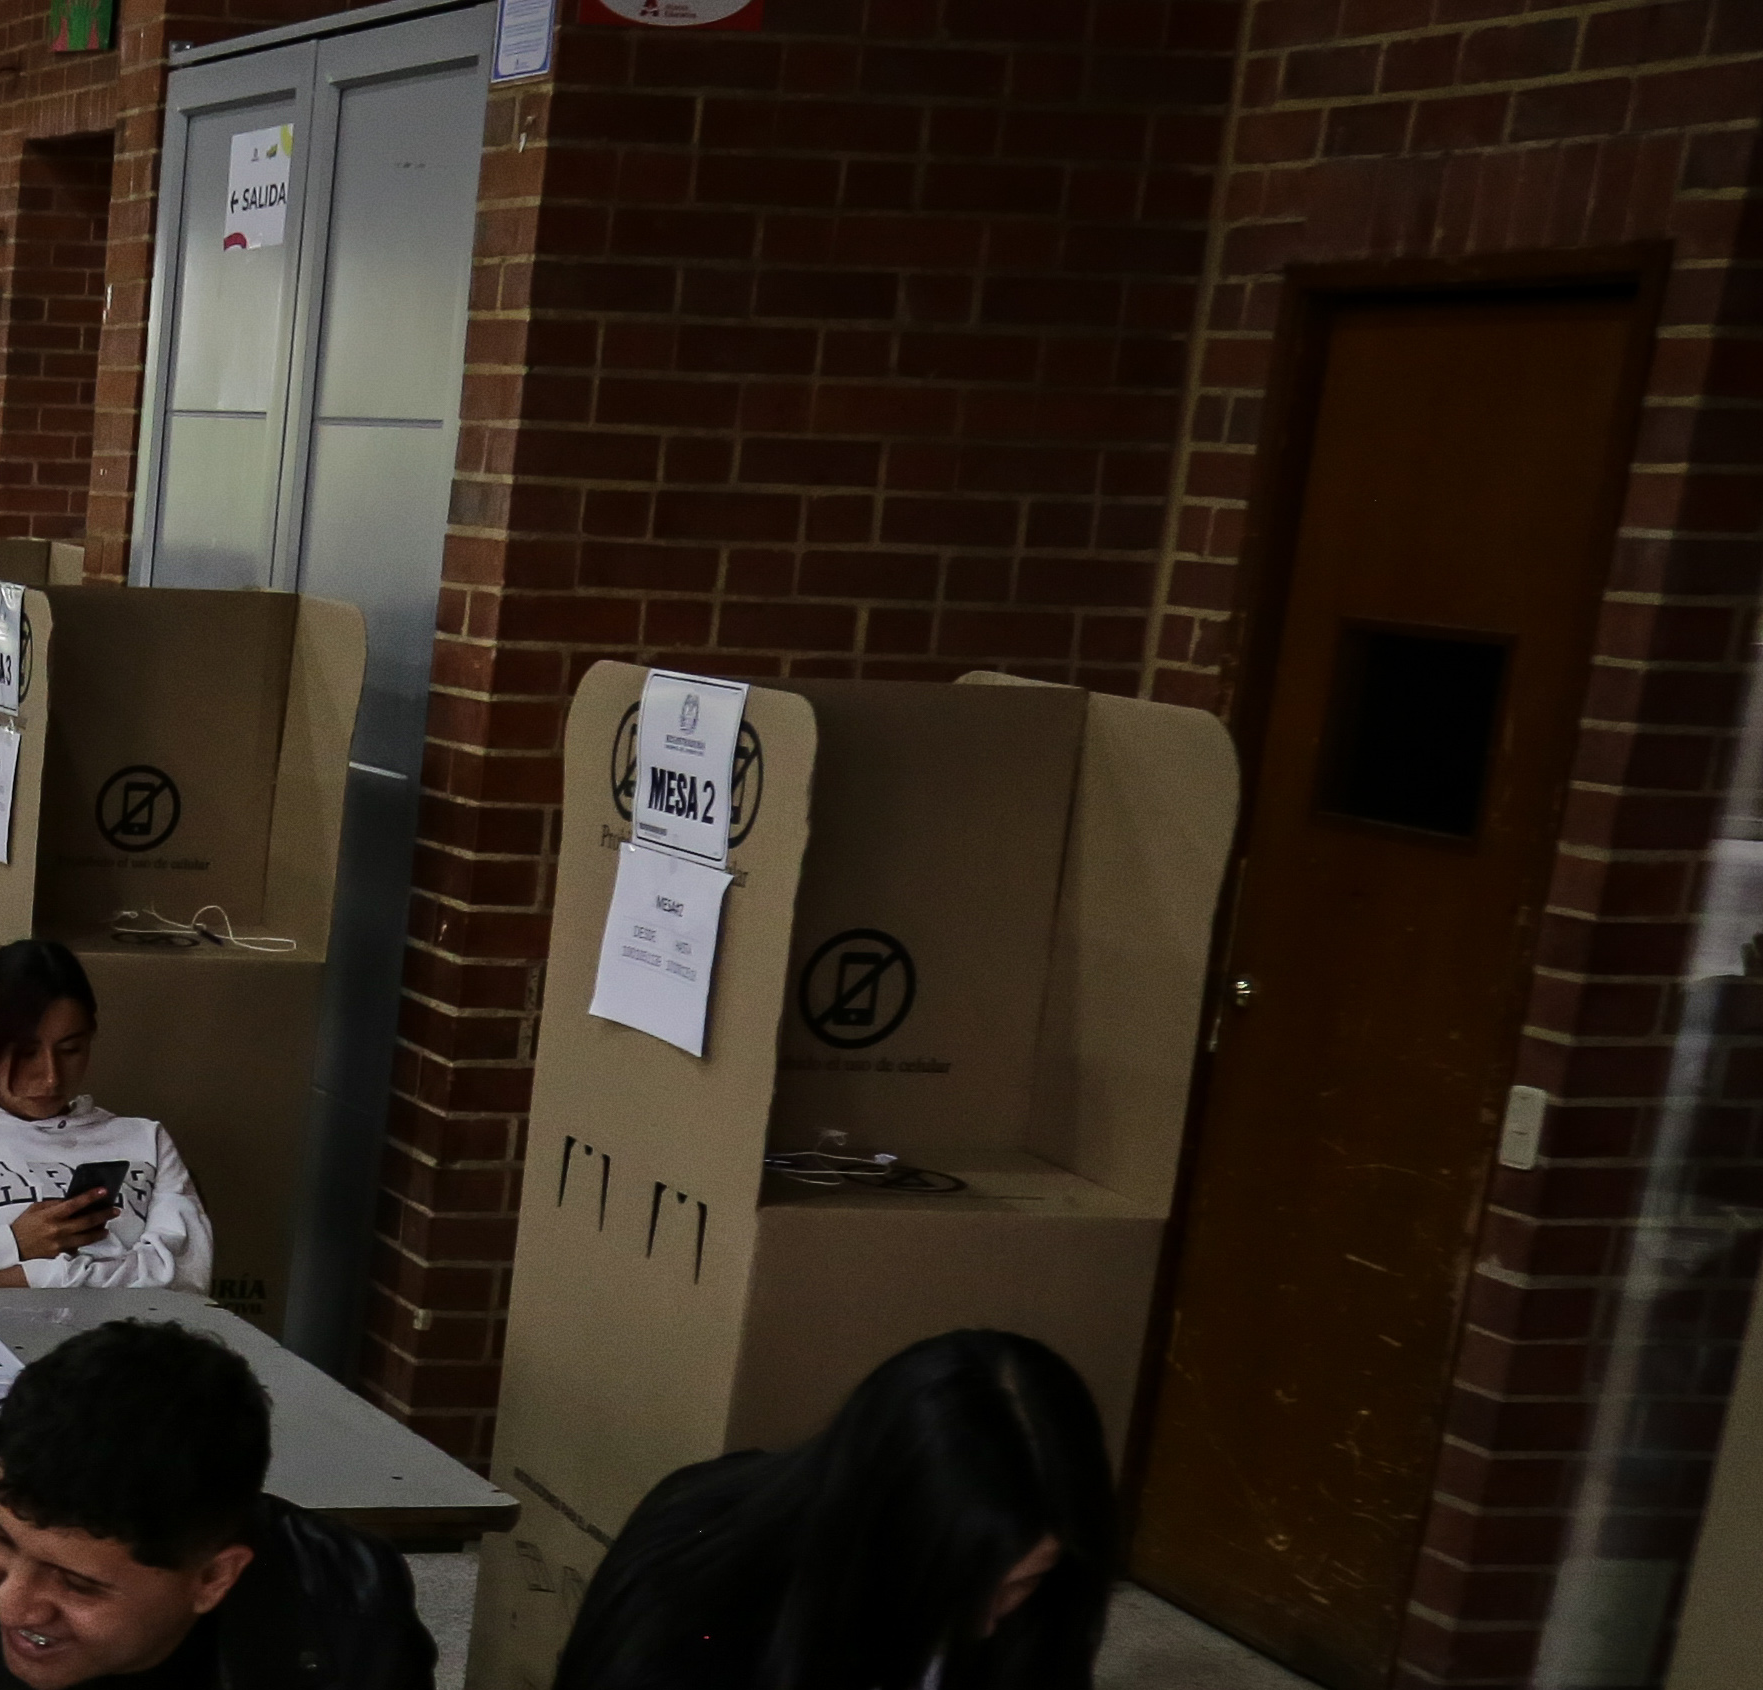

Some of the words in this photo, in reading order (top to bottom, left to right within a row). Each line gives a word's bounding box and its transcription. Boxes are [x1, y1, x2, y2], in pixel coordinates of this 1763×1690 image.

[242, 182, 287, 211] SALIDA
[5, 655, 13, 686] 3
[647, 766, 699, 822] MESA
[700, 780, 716, 825] 2
